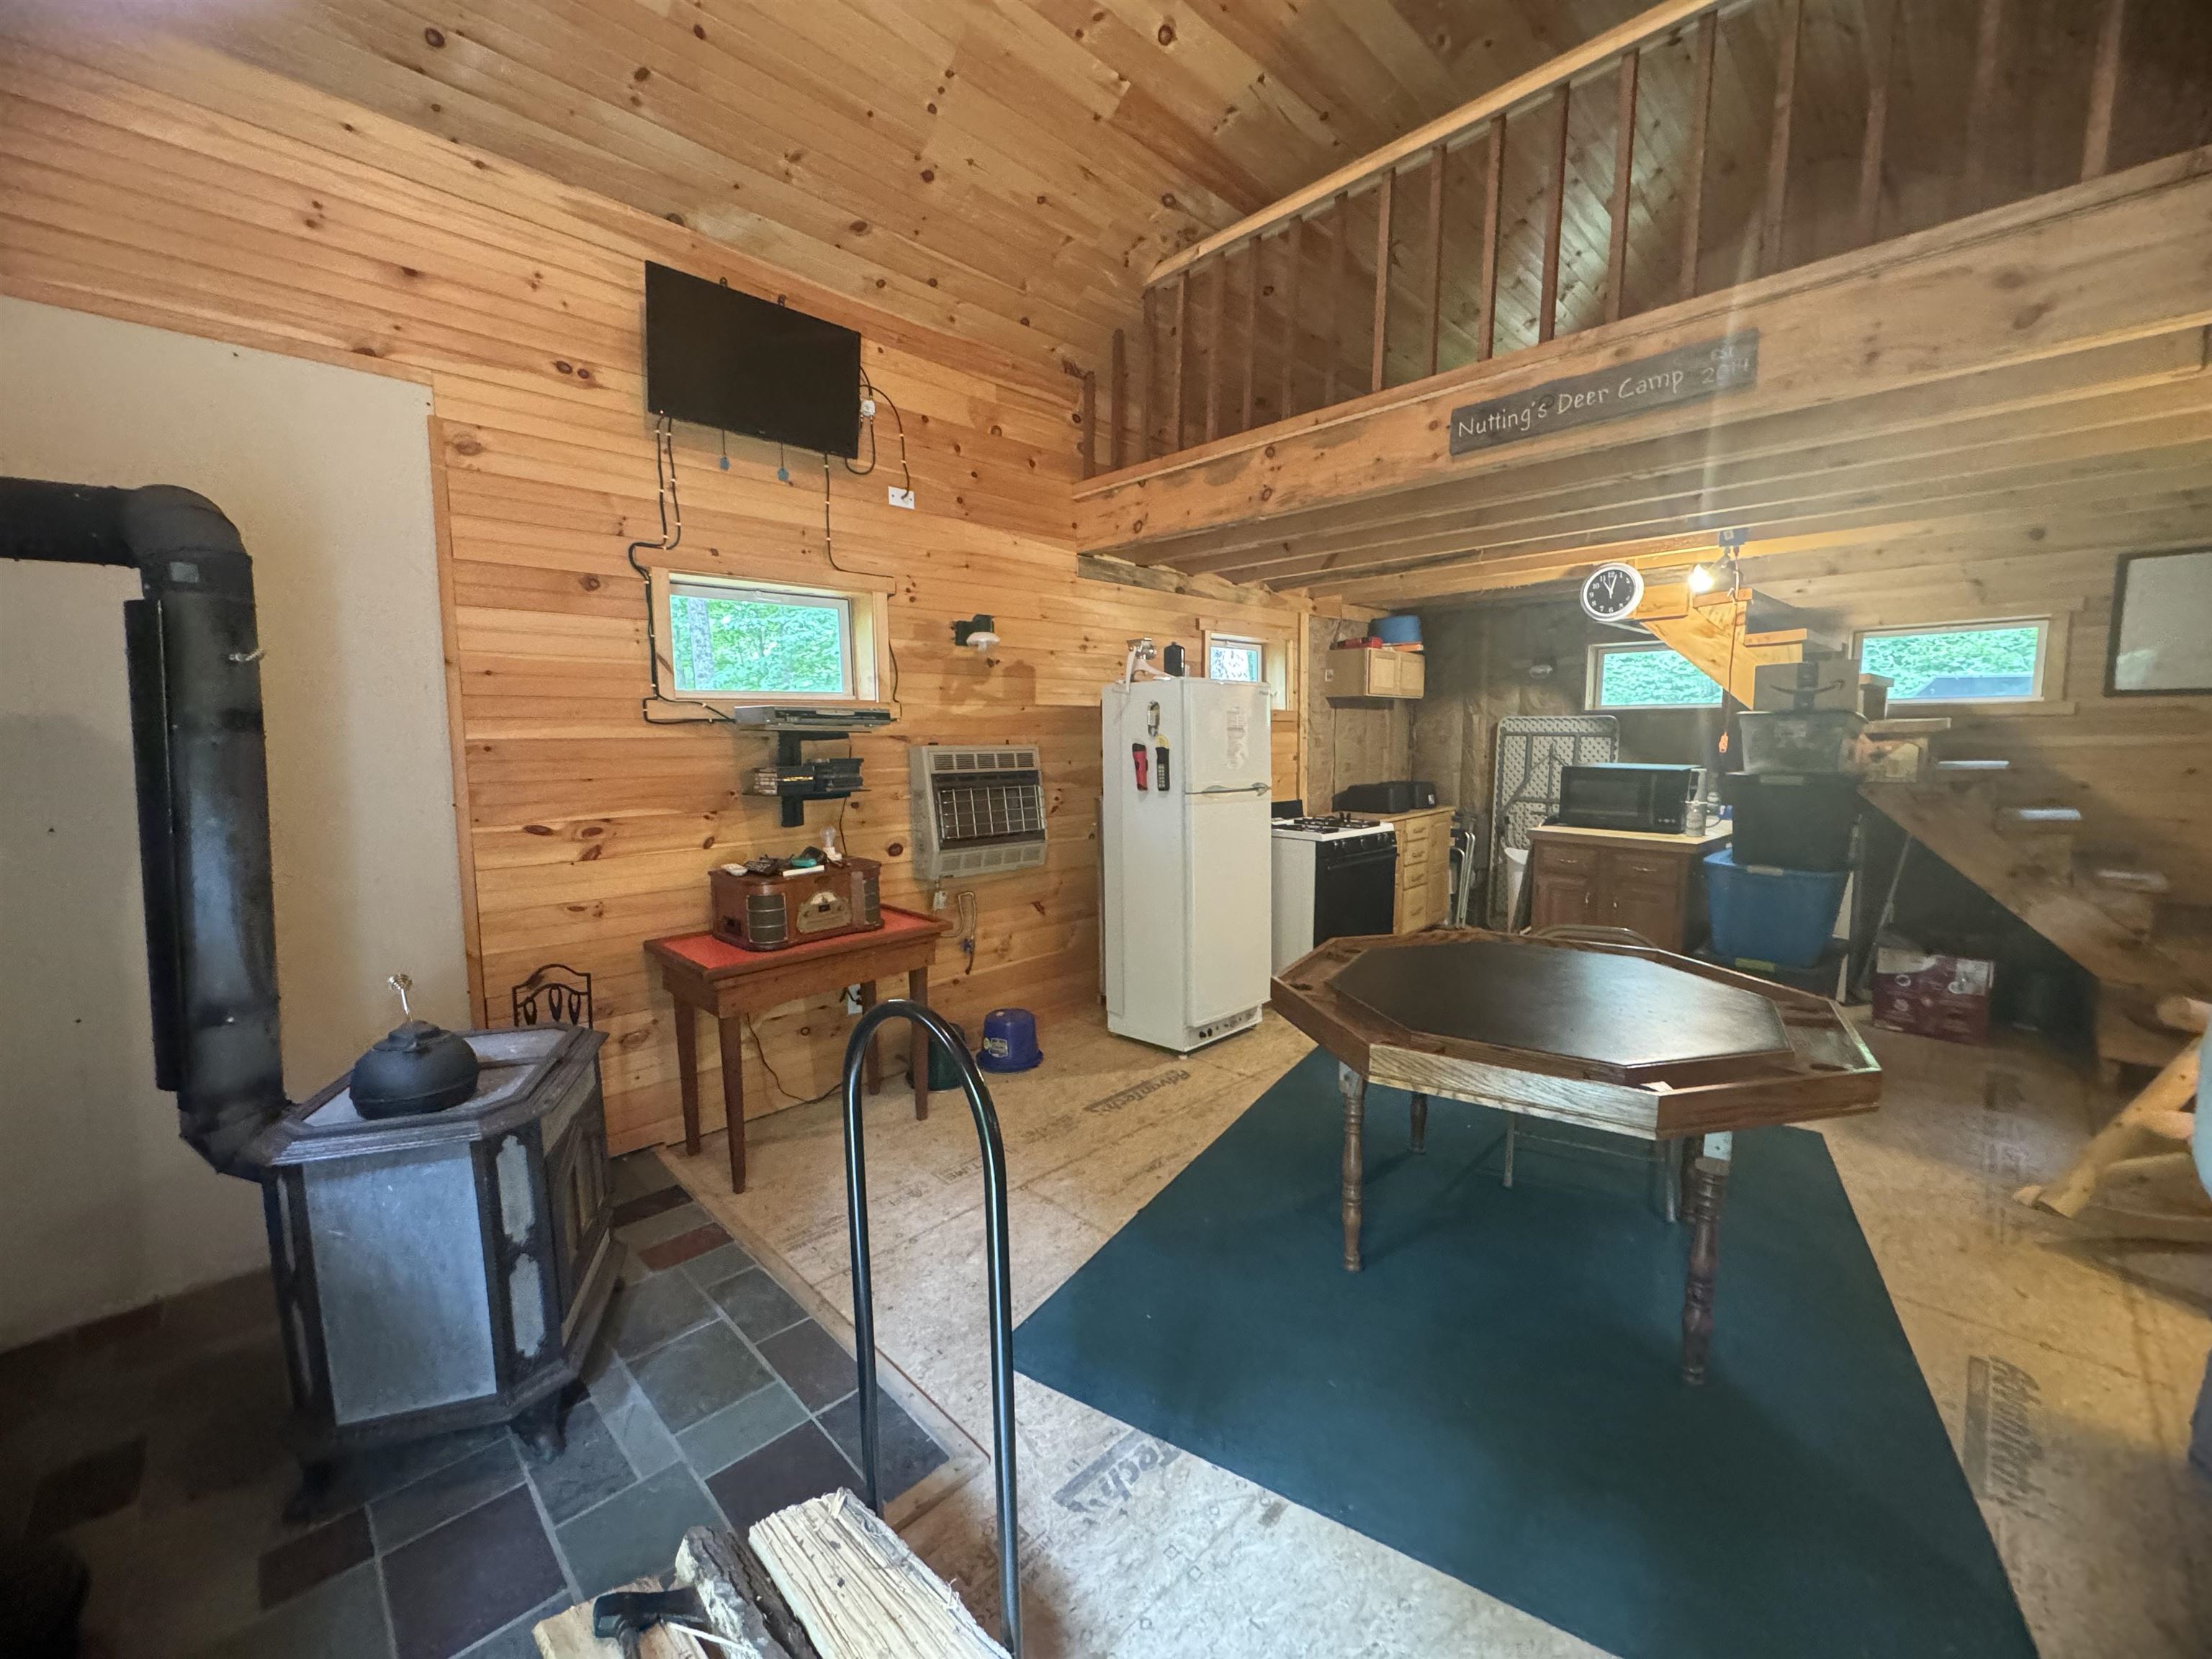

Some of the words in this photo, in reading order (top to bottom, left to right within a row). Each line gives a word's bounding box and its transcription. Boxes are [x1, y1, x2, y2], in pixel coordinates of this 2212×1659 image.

[1458, 398, 1548, 438] Nutting's
[1557, 387, 1609, 414] Deer
[1617, 369, 1685, 397] Camp
